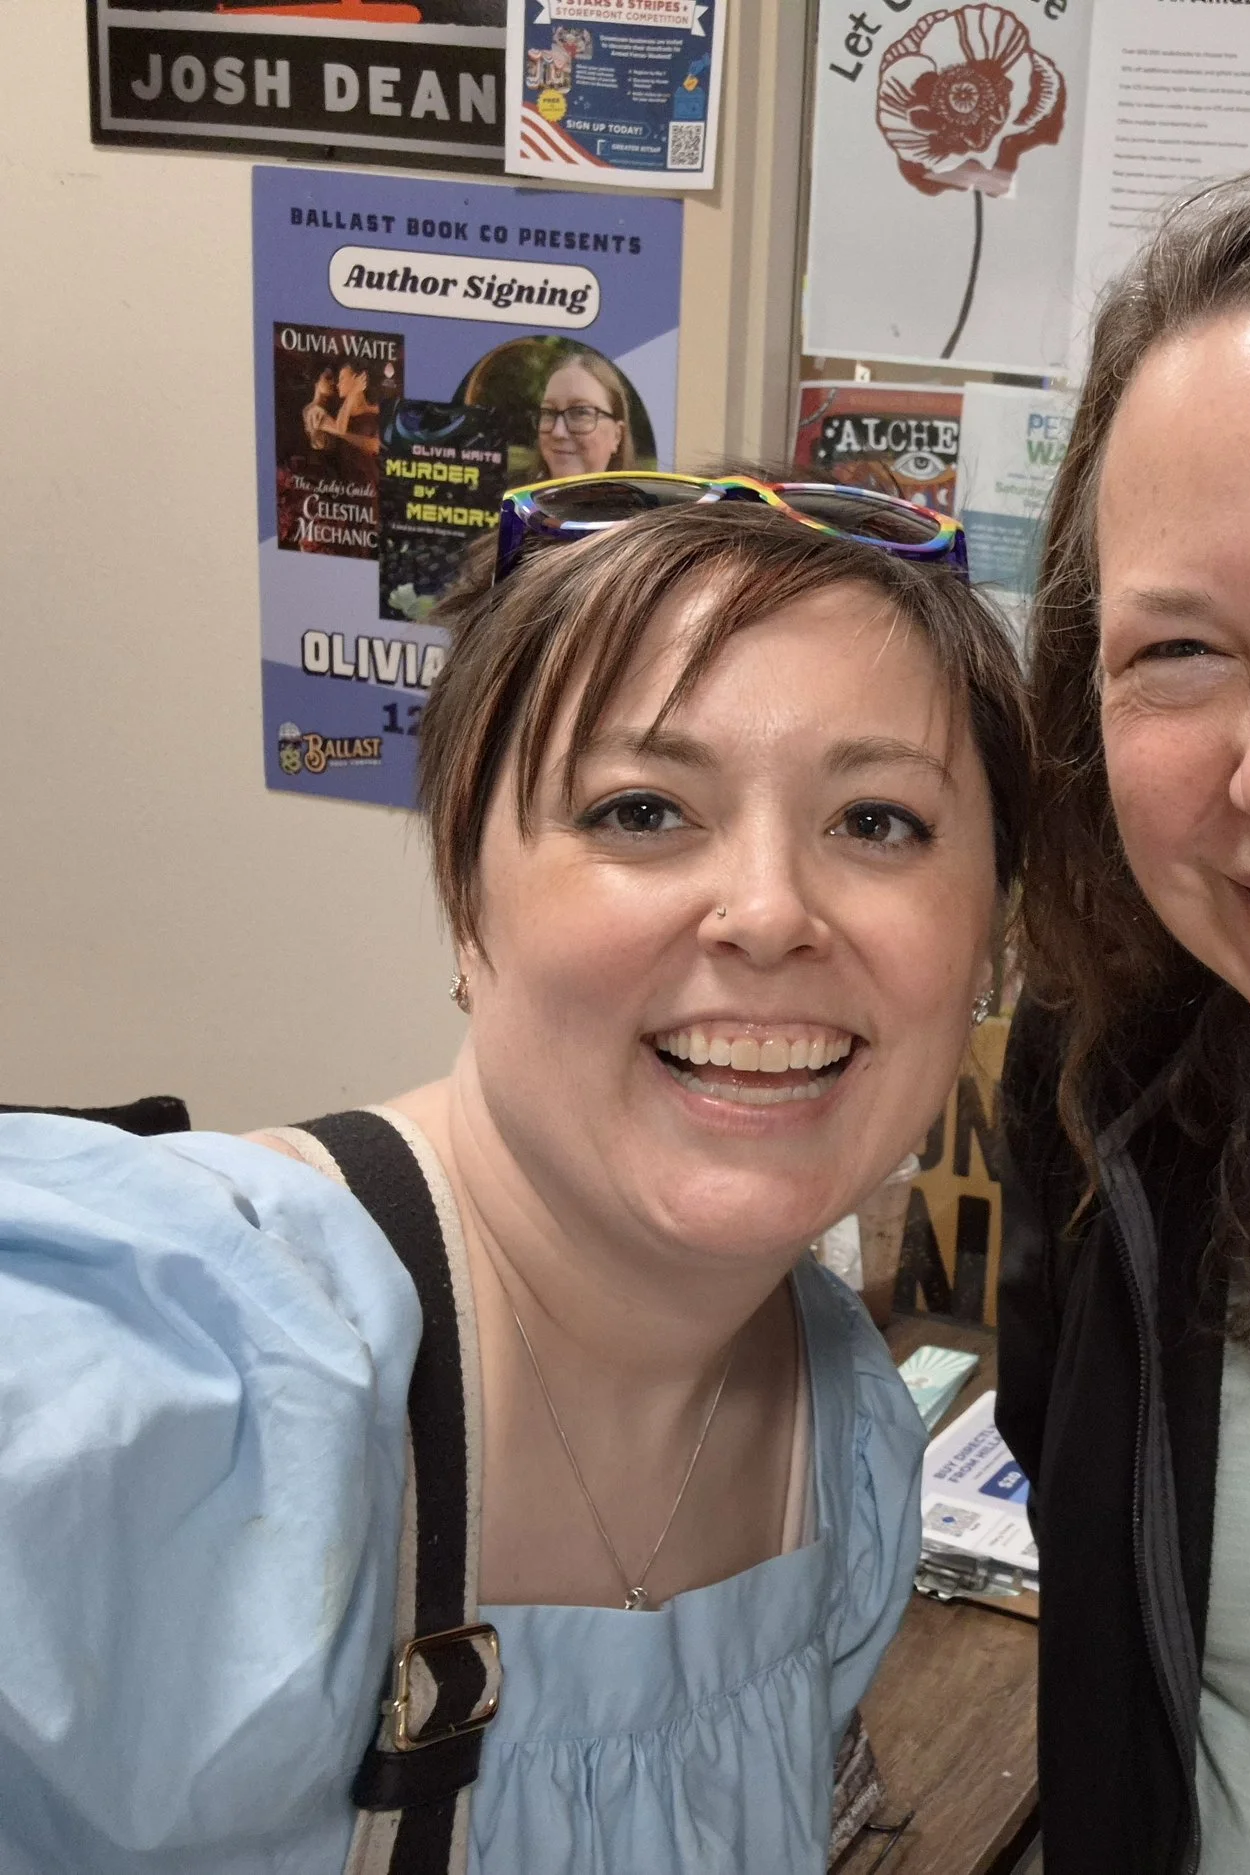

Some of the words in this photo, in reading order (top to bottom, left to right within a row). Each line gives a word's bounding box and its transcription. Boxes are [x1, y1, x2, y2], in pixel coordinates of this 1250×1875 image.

[555, 7, 622, 18] STOREFRONT
[626, 11, 689, 24] COMPETITION
[829, 12, 882, 83] Let
[131, 53, 291, 108] JOSH
[323, 63, 497, 125] DEAN
[566, 120, 590, 130] SIGN
[592, 123, 606, 132] UP
[608, 125, 643, 135] TODAY!
[290, 207, 396, 234] BALLAST
[407, 218, 468, 241] BOOK
[480, 224, 508, 244] CO
[519, 228, 642, 255] PRESENTS
[344, 264, 458, 298] Author
[462, 273, 592, 316] Signing
[281, 328, 339, 355] OLIVIA
[341, 335, 397, 361] WAITE
[412, 445, 456, 459] OLIVIA
[461, 450, 502, 464] WAITE
[386, 459, 480, 485] MURDER
[413, 485, 436, 498] BY
[303, 494, 377, 525] CELESTIAL
[406, 503, 500, 528] MEMORY
[302, 629, 446, 689] OLIVIA
[302, 732, 382, 774] BALLAST
